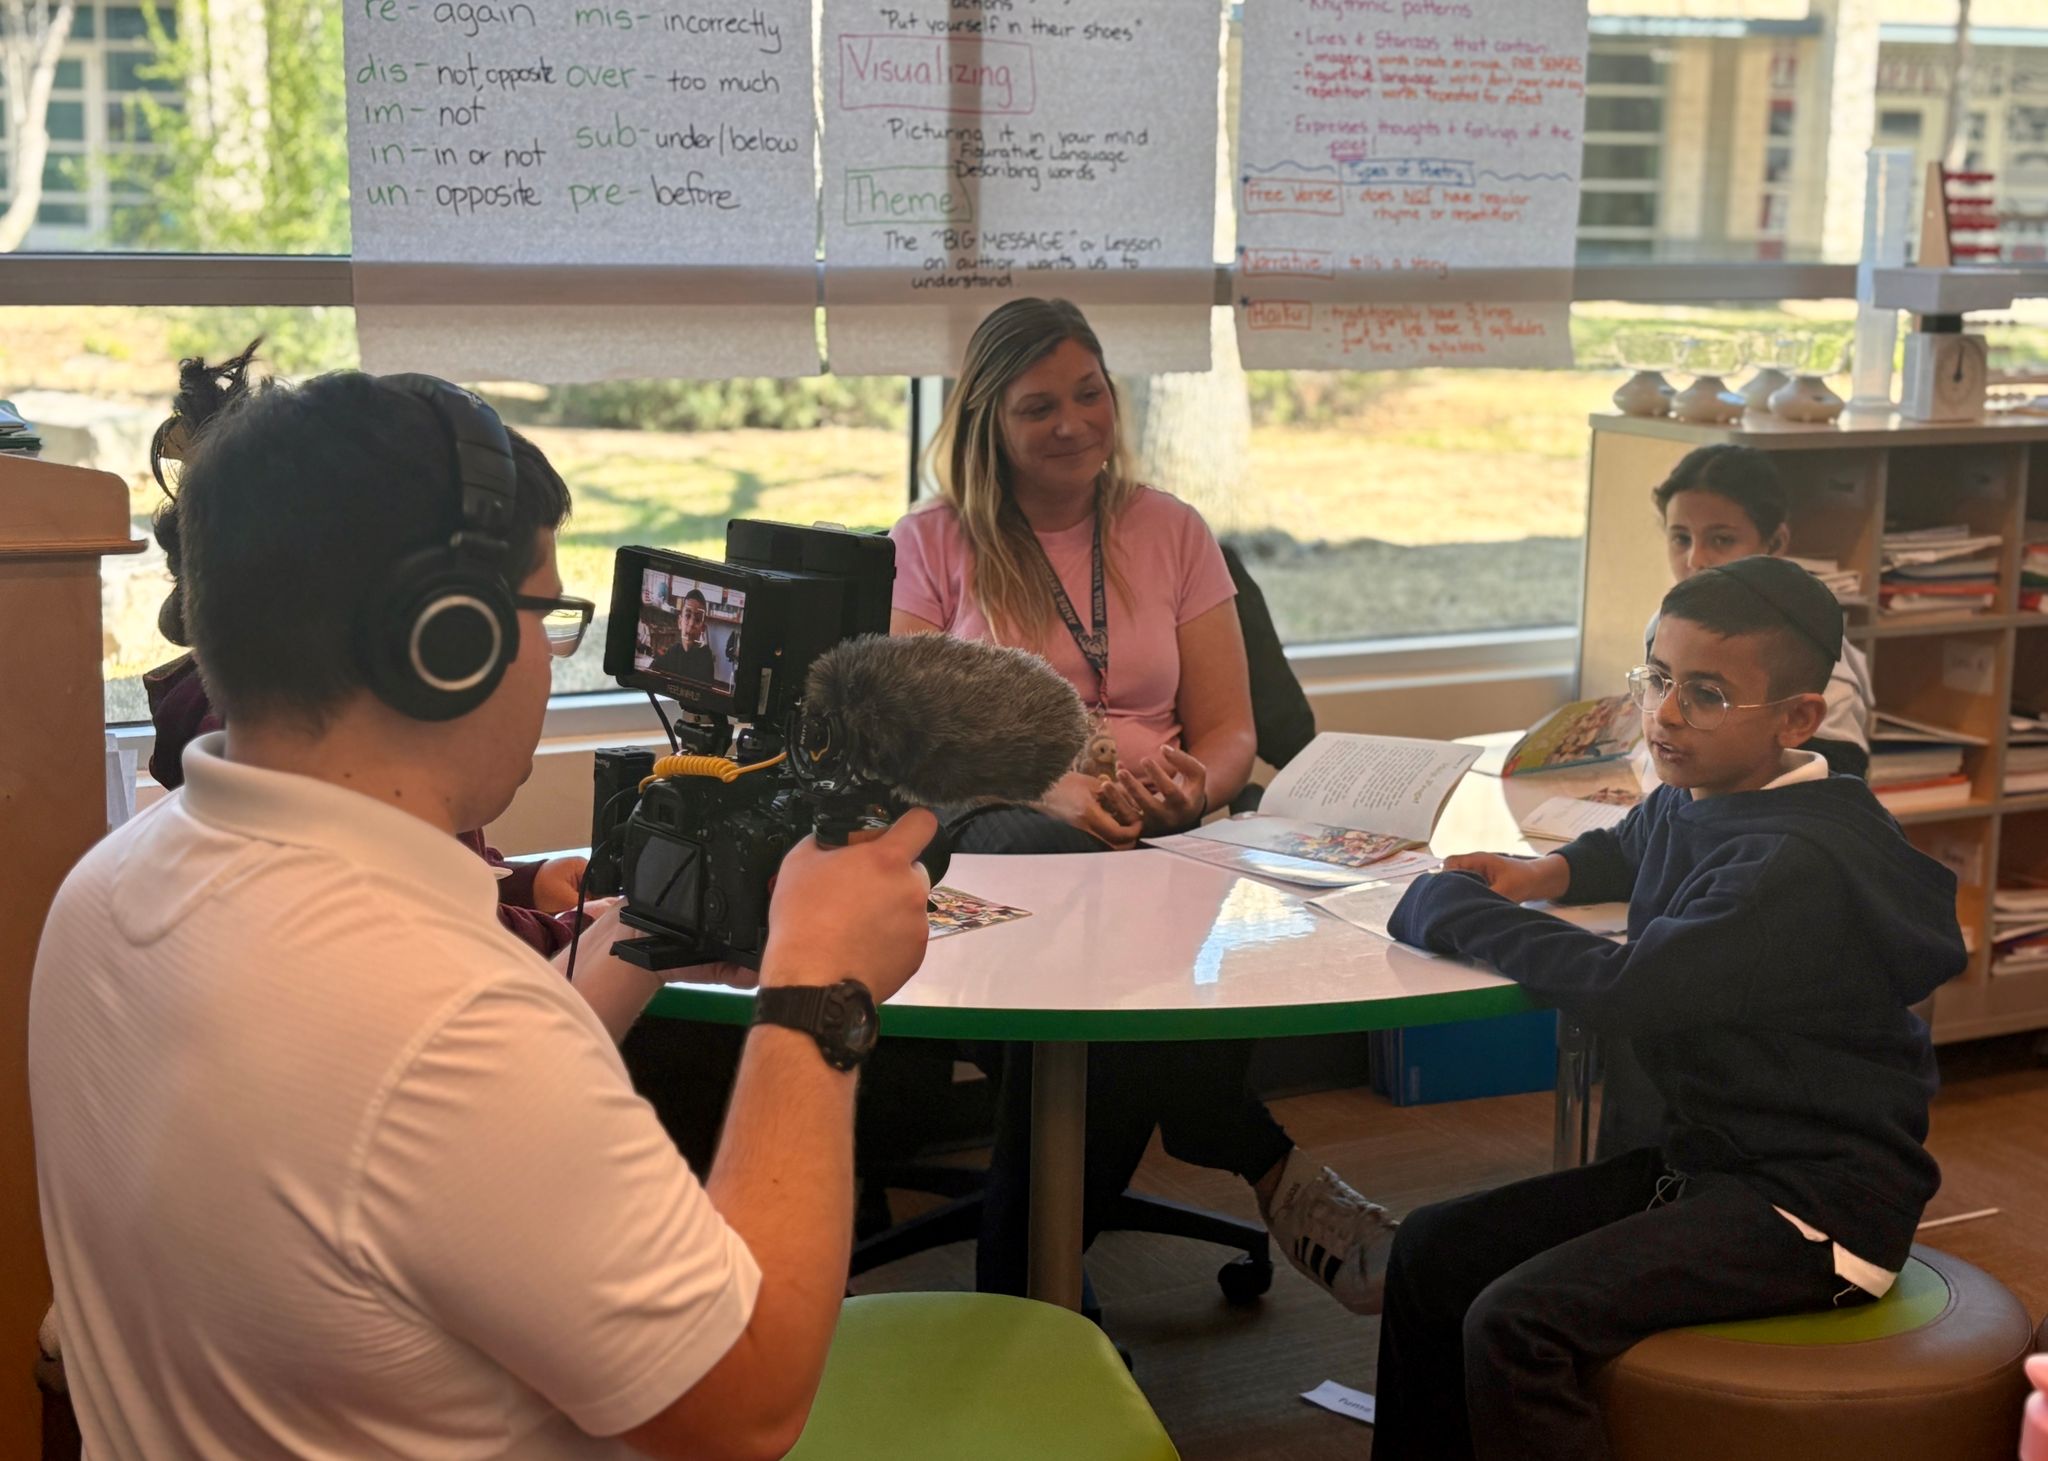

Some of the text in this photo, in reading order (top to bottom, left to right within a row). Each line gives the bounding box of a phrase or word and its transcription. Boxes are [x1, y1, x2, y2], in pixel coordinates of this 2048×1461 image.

[433, 2, 536, 37] again
[1402, 1, 1473, 21] patterns
[664, 10, 782, 53] incorrectly
[926, 17, 999, 35] yourself
[1007, 22, 1021, 35] in
[1031, 18, 1075, 36] their
[1306, 28, 1347, 46] Lines
[1375, 30, 1439, 49] Stanzas
[1453, 34, 1488, 51] that
[668, 68, 706, 93] too
[719, 70, 780, 94] much
[847, 39, 1013, 110] Visualizing
[440, 100, 486, 127] not
[888, 118, 1149, 147] Picturing it in your mind
[434, 146, 457, 166] in
[469, 149, 493, 166] or
[504, 146, 547, 168] not
[960, 146, 1129, 172] Figurative Language
[954, 161, 1096, 191] Describing words
[435, 180, 541, 212] opposite
[651, 171, 741, 210] before
[850, 174, 956, 215] Theme
[1248, 184, 1337, 204] Free Verse
[1360, 189, 1395, 203] does
[1442, 190, 1473, 203] have
[1373, 208, 1420, 225] rhyme
[1430, 209, 1445, 220] or
[884, 230, 919, 251] The
[1104, 233, 1162, 253] Lesson
[923, 253, 1140, 271] an author wants us to
[1244, 251, 1322, 271] Narrative
[1349, 255, 1382, 270] tells
[1392, 258, 1402, 270] a
[911, 270, 1013, 289] understand
